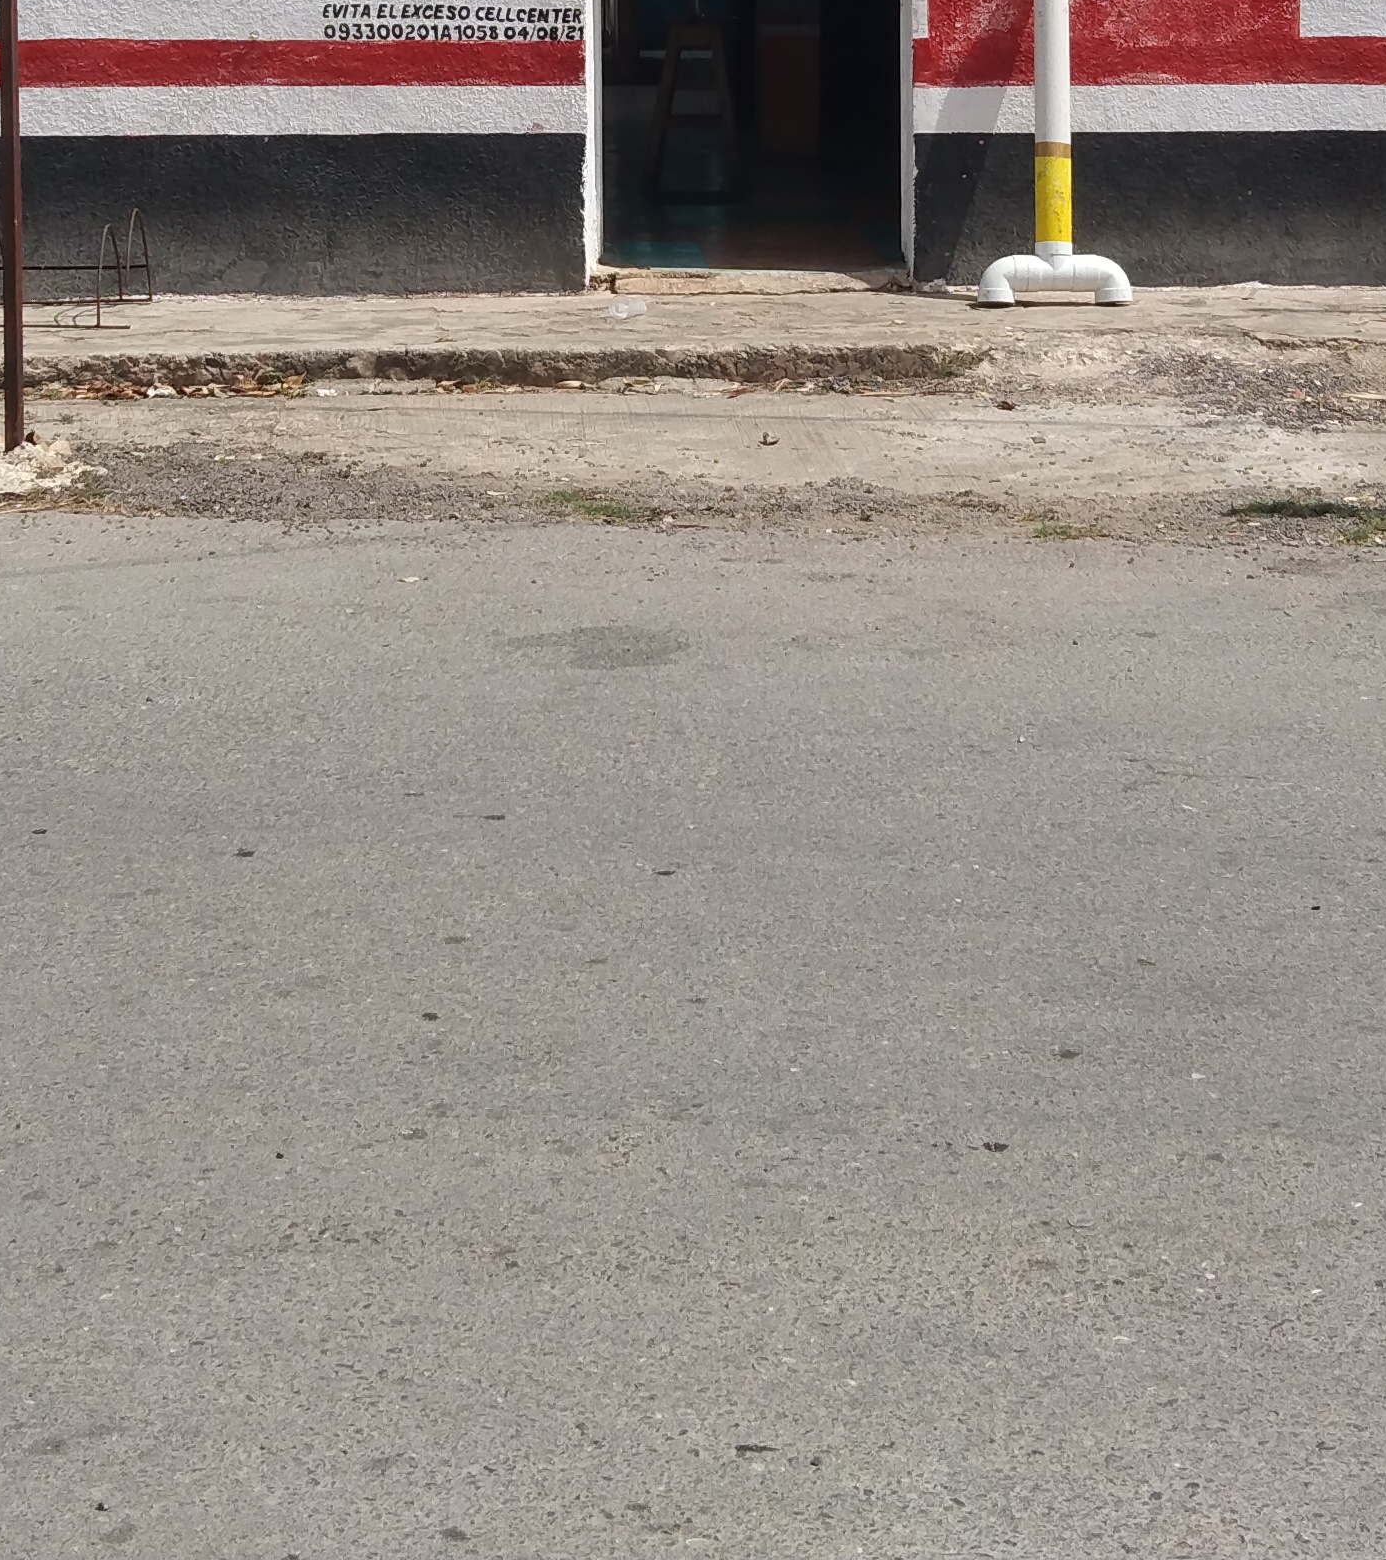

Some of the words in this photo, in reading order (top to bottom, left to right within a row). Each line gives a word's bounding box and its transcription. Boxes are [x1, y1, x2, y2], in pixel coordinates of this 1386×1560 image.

[322, 3, 371, 19] EVITA
[376, 4, 400, 19] EL
[401, 4, 471, 20] EXCESO
